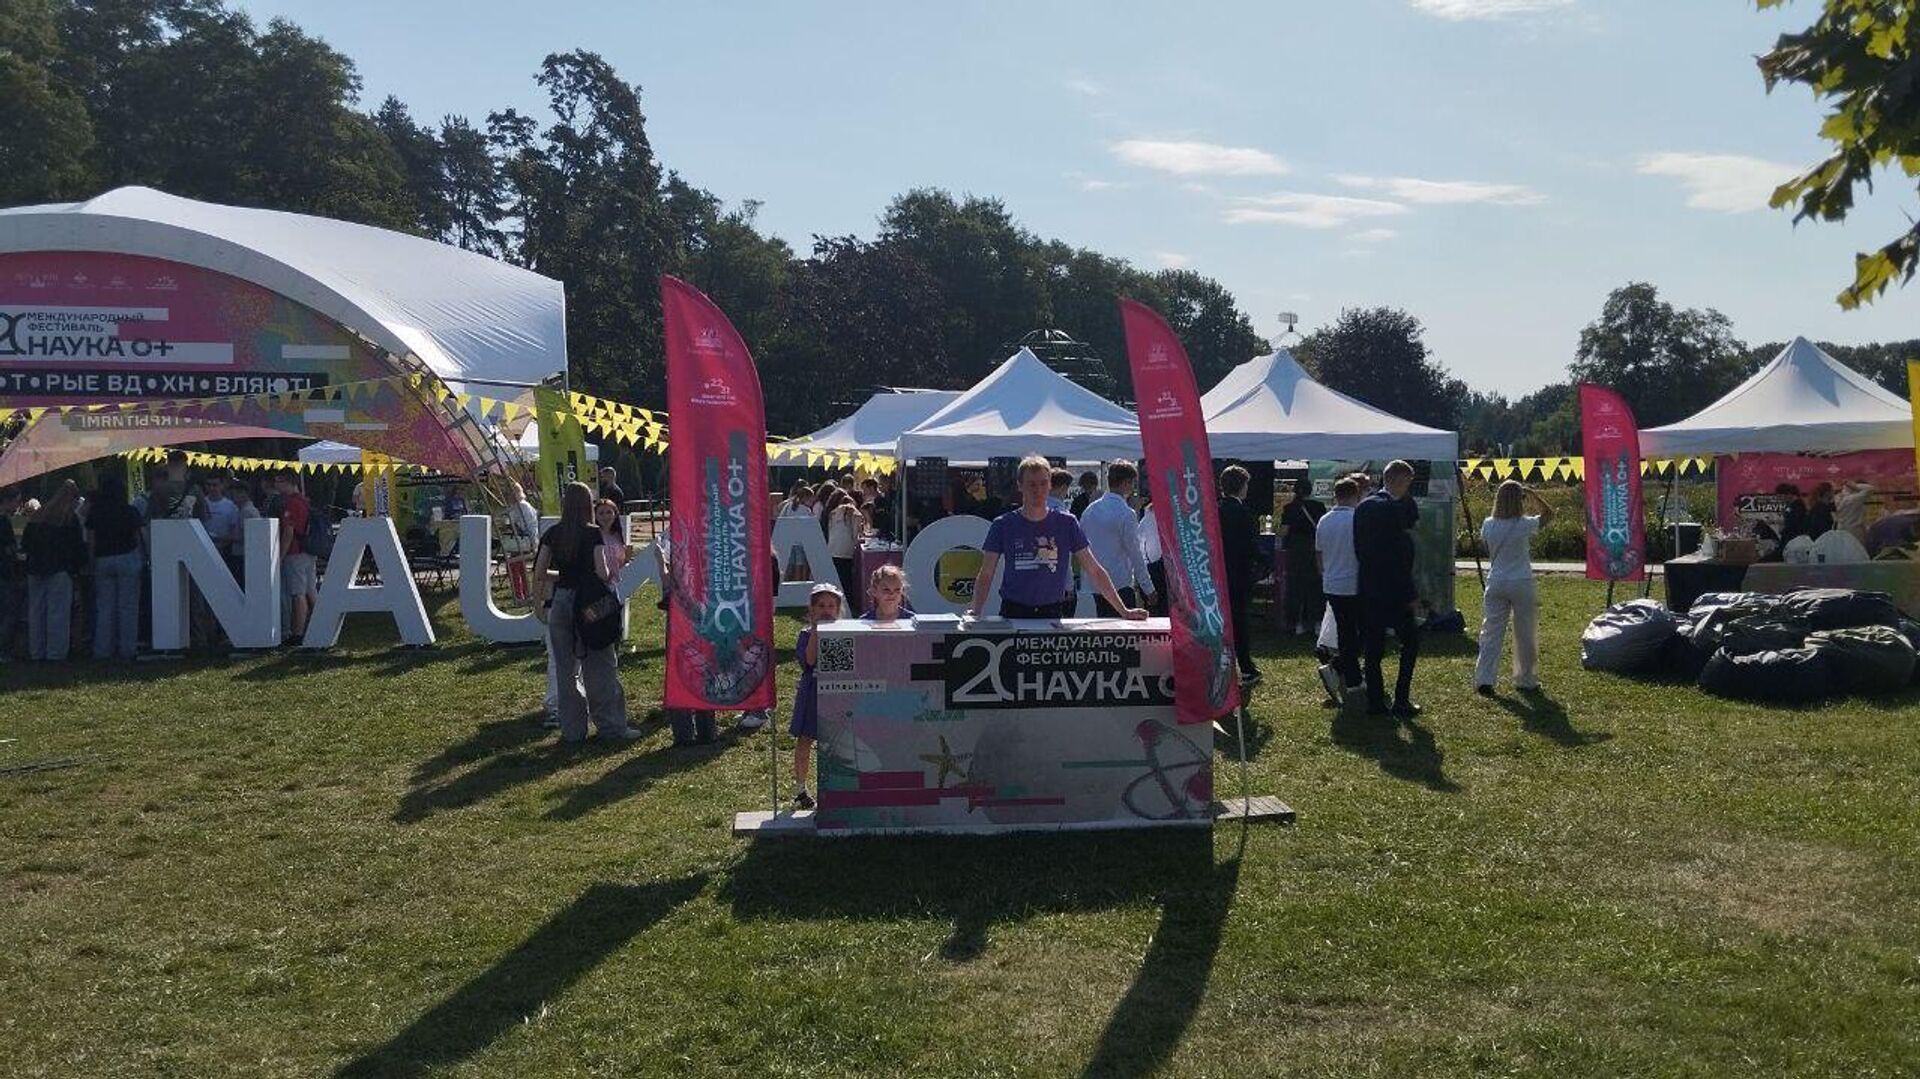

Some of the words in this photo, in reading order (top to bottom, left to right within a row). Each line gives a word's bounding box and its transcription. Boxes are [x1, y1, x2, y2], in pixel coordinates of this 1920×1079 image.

[27, 312, 144, 325] МЕЖДУНАРОДНЫЙ
[27, 323, 104, 333] ФЕСТИВАЛЬ
[28, 336, 125, 357] НАУКА
[729, 503, 747, 590] НАУКА
[1189, 509, 1215, 596] НАУКА
[1017, 652, 1120, 665] ФЕСТИВАЛЬ
[1017, 668, 1150, 700] НАУКА
